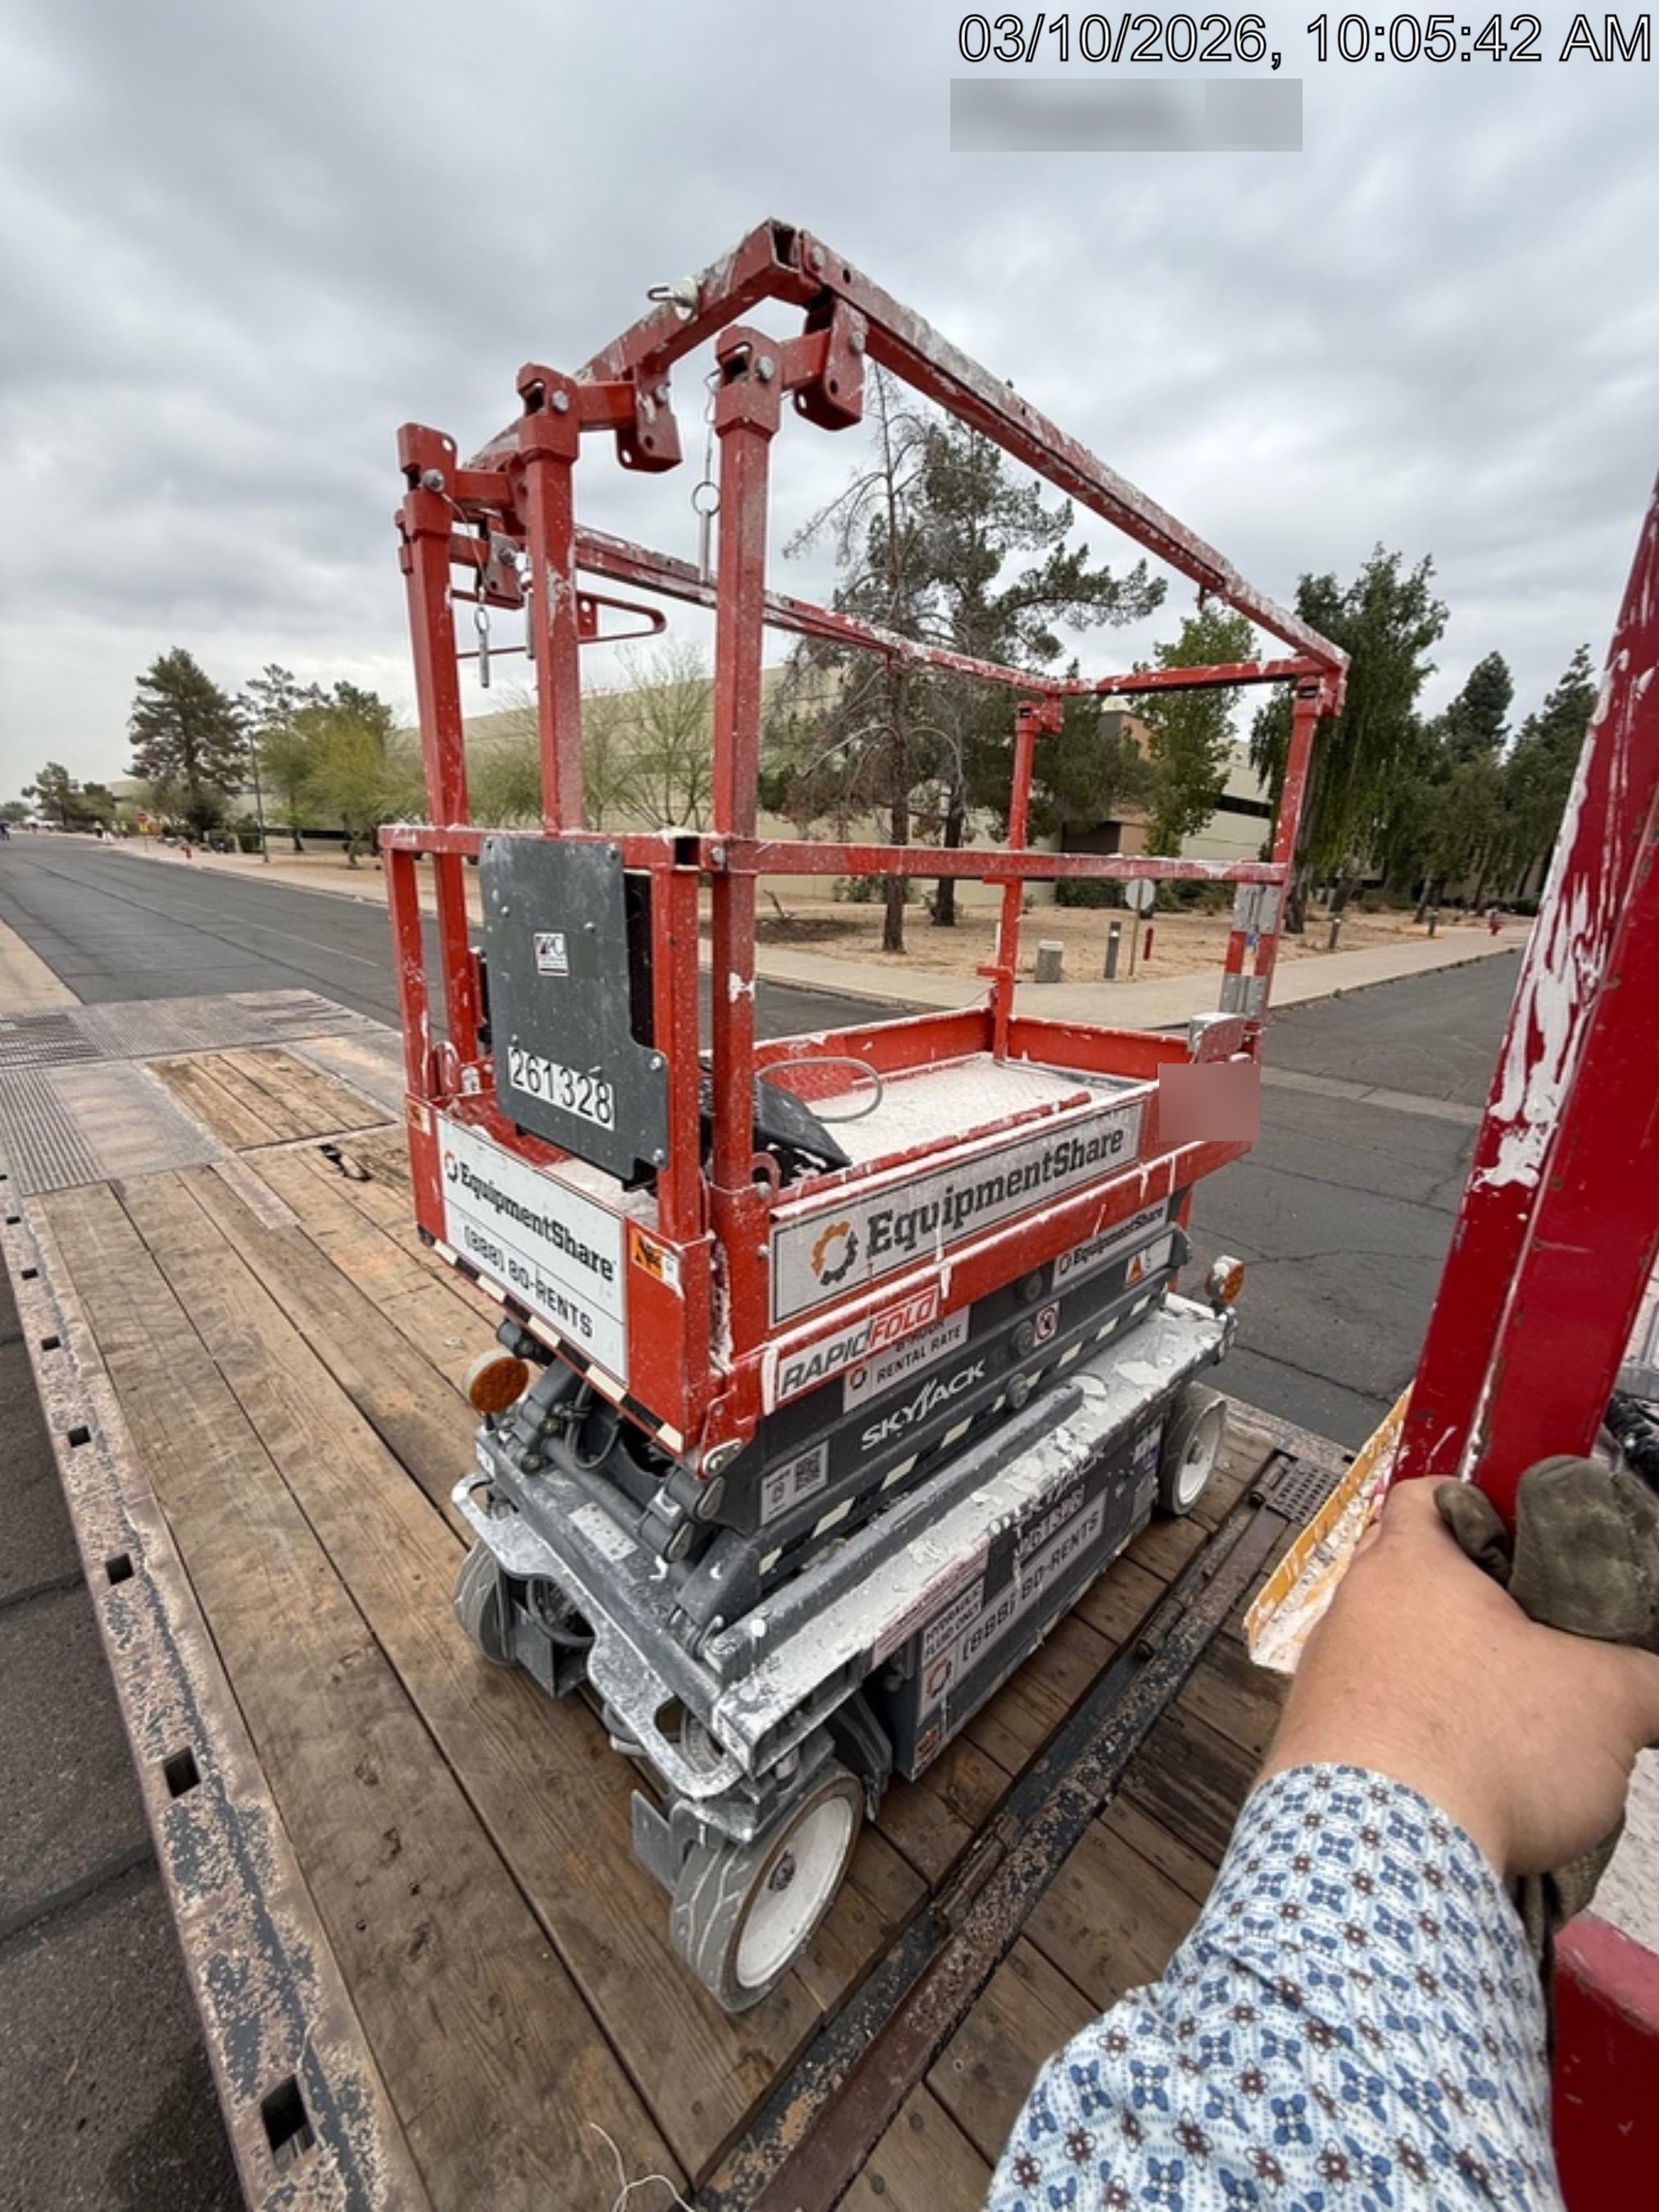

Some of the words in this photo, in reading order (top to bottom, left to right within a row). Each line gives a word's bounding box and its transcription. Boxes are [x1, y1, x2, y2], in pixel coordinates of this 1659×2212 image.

[509, 1048, 614, 1126] 261328
[458, 1161, 614, 1282] EquipmentShare
[866, 1127, 1124, 1255] EquipmentShare
[877, 1346, 926, 1385] RENTAL
[931, 1323, 962, 1353] RATE
[861, 1360, 986, 1452] SKYJACK
